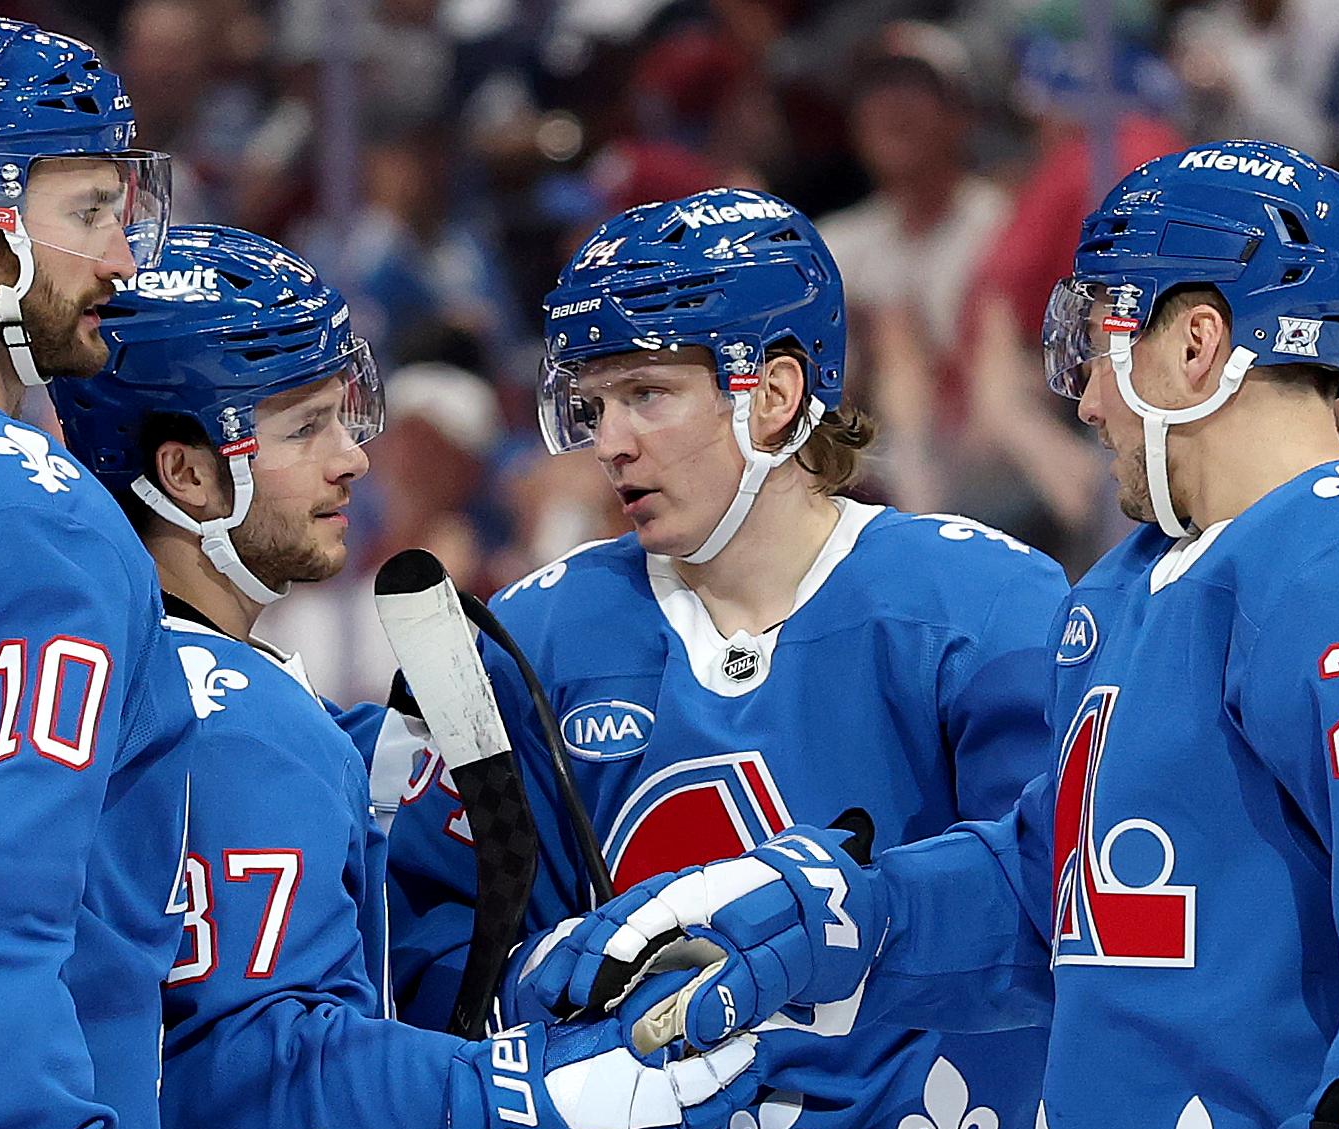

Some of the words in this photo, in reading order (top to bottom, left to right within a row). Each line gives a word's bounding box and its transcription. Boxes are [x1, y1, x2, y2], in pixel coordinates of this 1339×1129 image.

[1178, 150, 1297, 187] Kiewit
[551, 298, 602, 320] BAUER
[727, 657, 754, 675] NHL
[575, 714, 644, 745] IMA
